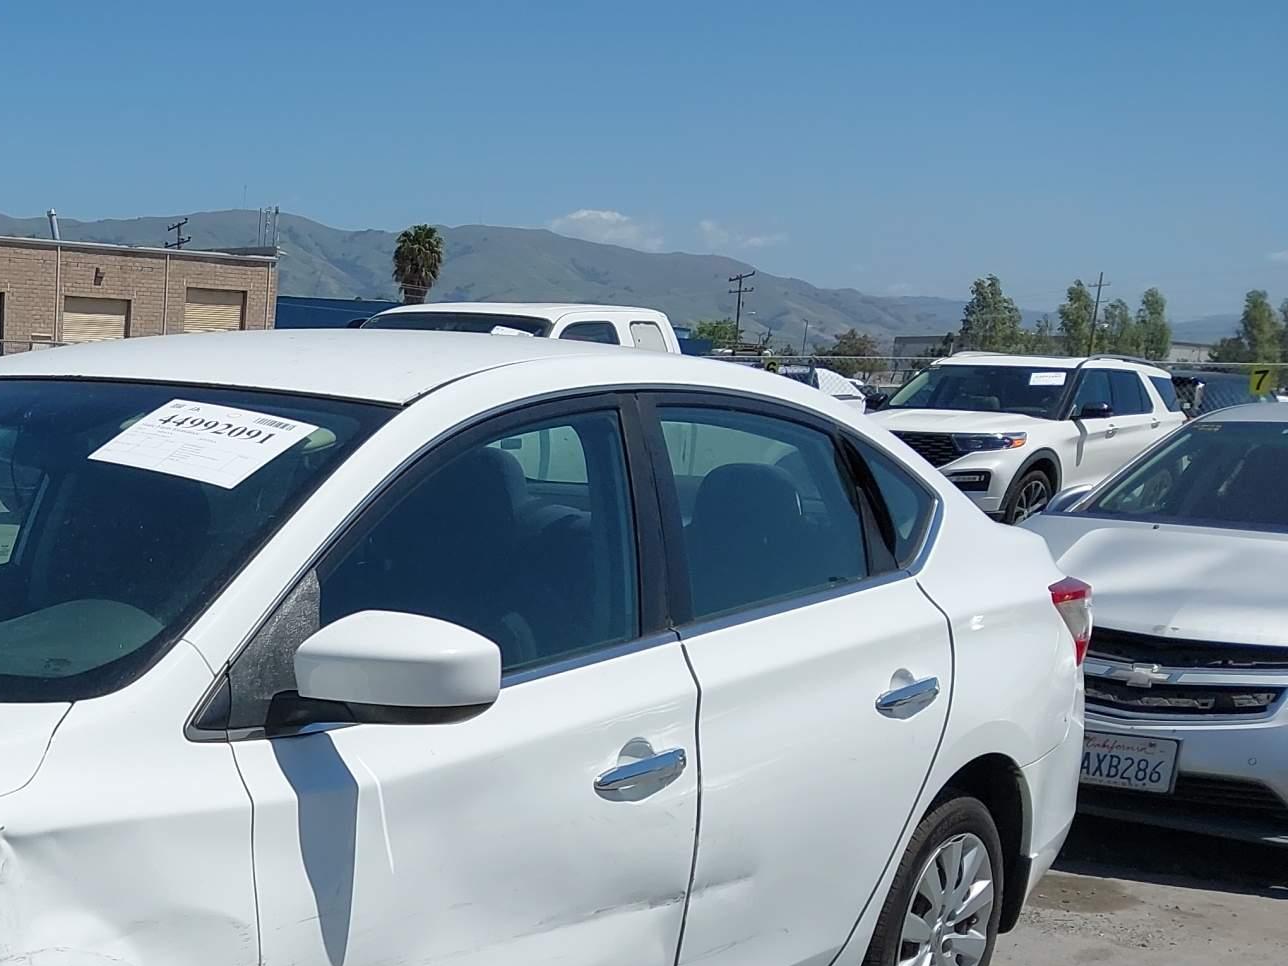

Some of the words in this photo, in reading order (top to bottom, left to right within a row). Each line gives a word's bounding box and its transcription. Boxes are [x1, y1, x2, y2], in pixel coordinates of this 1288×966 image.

[1254, 370, 1269, 391] 7
[158, 414, 276, 444] 44992091
[1085, 737, 1148, 753] California
